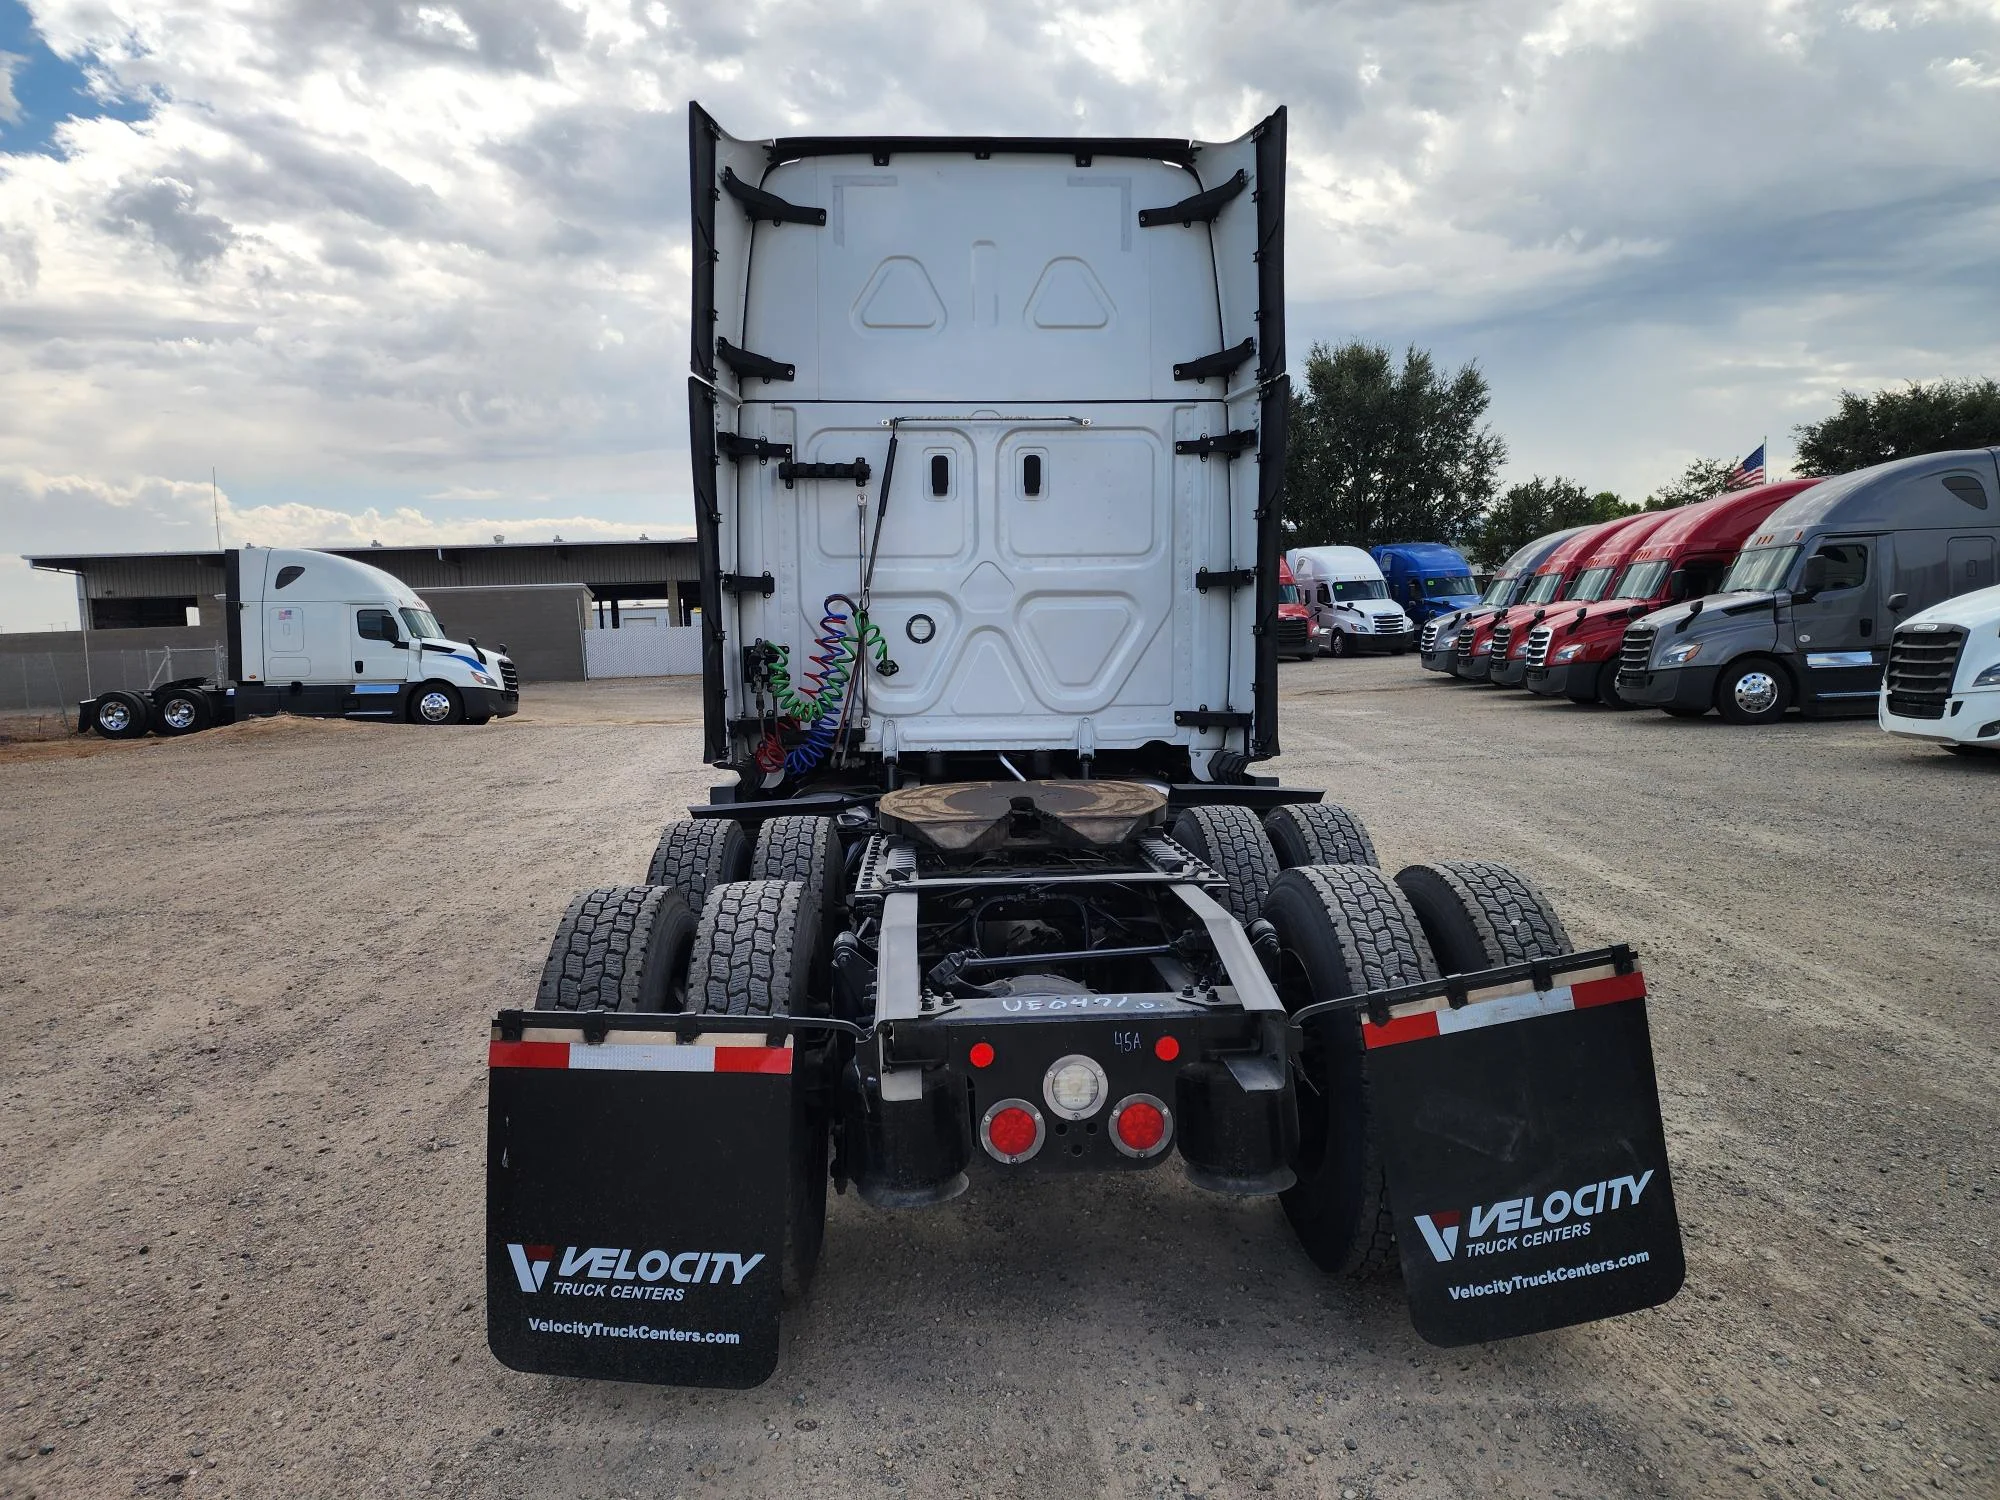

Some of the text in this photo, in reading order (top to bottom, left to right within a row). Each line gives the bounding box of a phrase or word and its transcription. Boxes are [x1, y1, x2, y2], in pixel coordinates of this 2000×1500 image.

[1114, 1031, 1143, 1054] 45A
[1468, 1169, 1655, 1239] VELOCITY
[1465, 1221, 1592, 1258] TRUCK CENTERS
[558, 1246, 766, 1285] VELOCITY
[1448, 1250, 1650, 1301] VelocityTruckCenters.com
[553, 1281, 686, 1302] TRUCK CENTERS
[528, 1317, 741, 1345] VelocityTruckCenters.com
